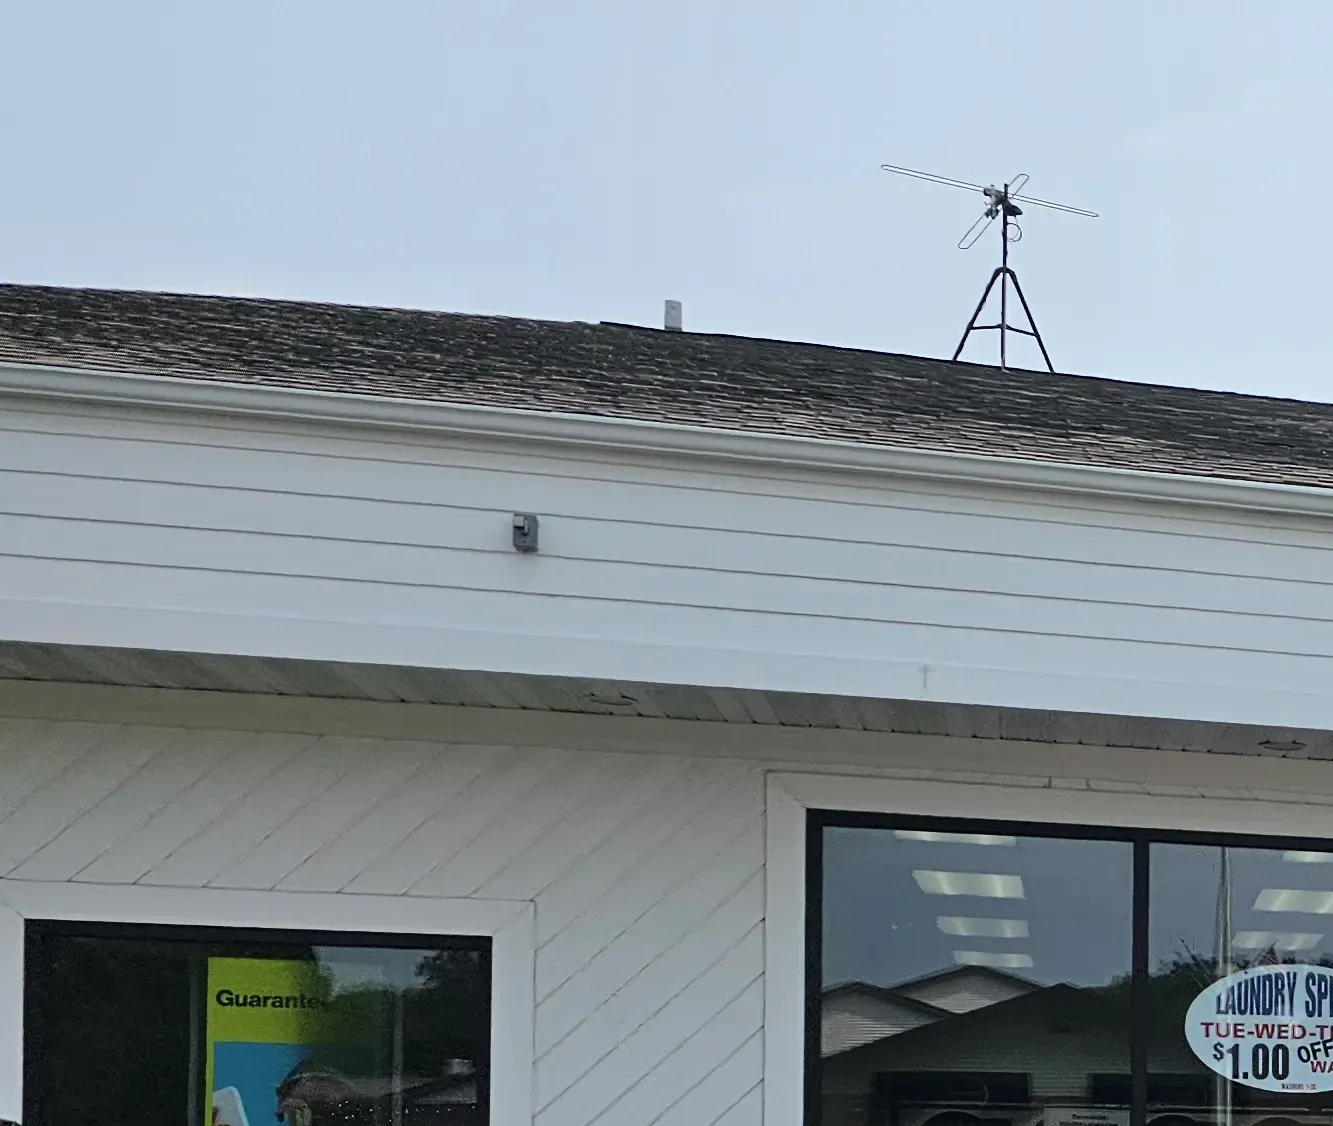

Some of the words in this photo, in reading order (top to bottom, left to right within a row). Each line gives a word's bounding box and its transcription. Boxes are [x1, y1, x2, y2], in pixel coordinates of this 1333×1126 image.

[1216, 972, 1298, 1017] LAUNDRY
[1212, 1042, 1290, 1081] $1.00
[1297, 1039, 1333, 1064] OFF
